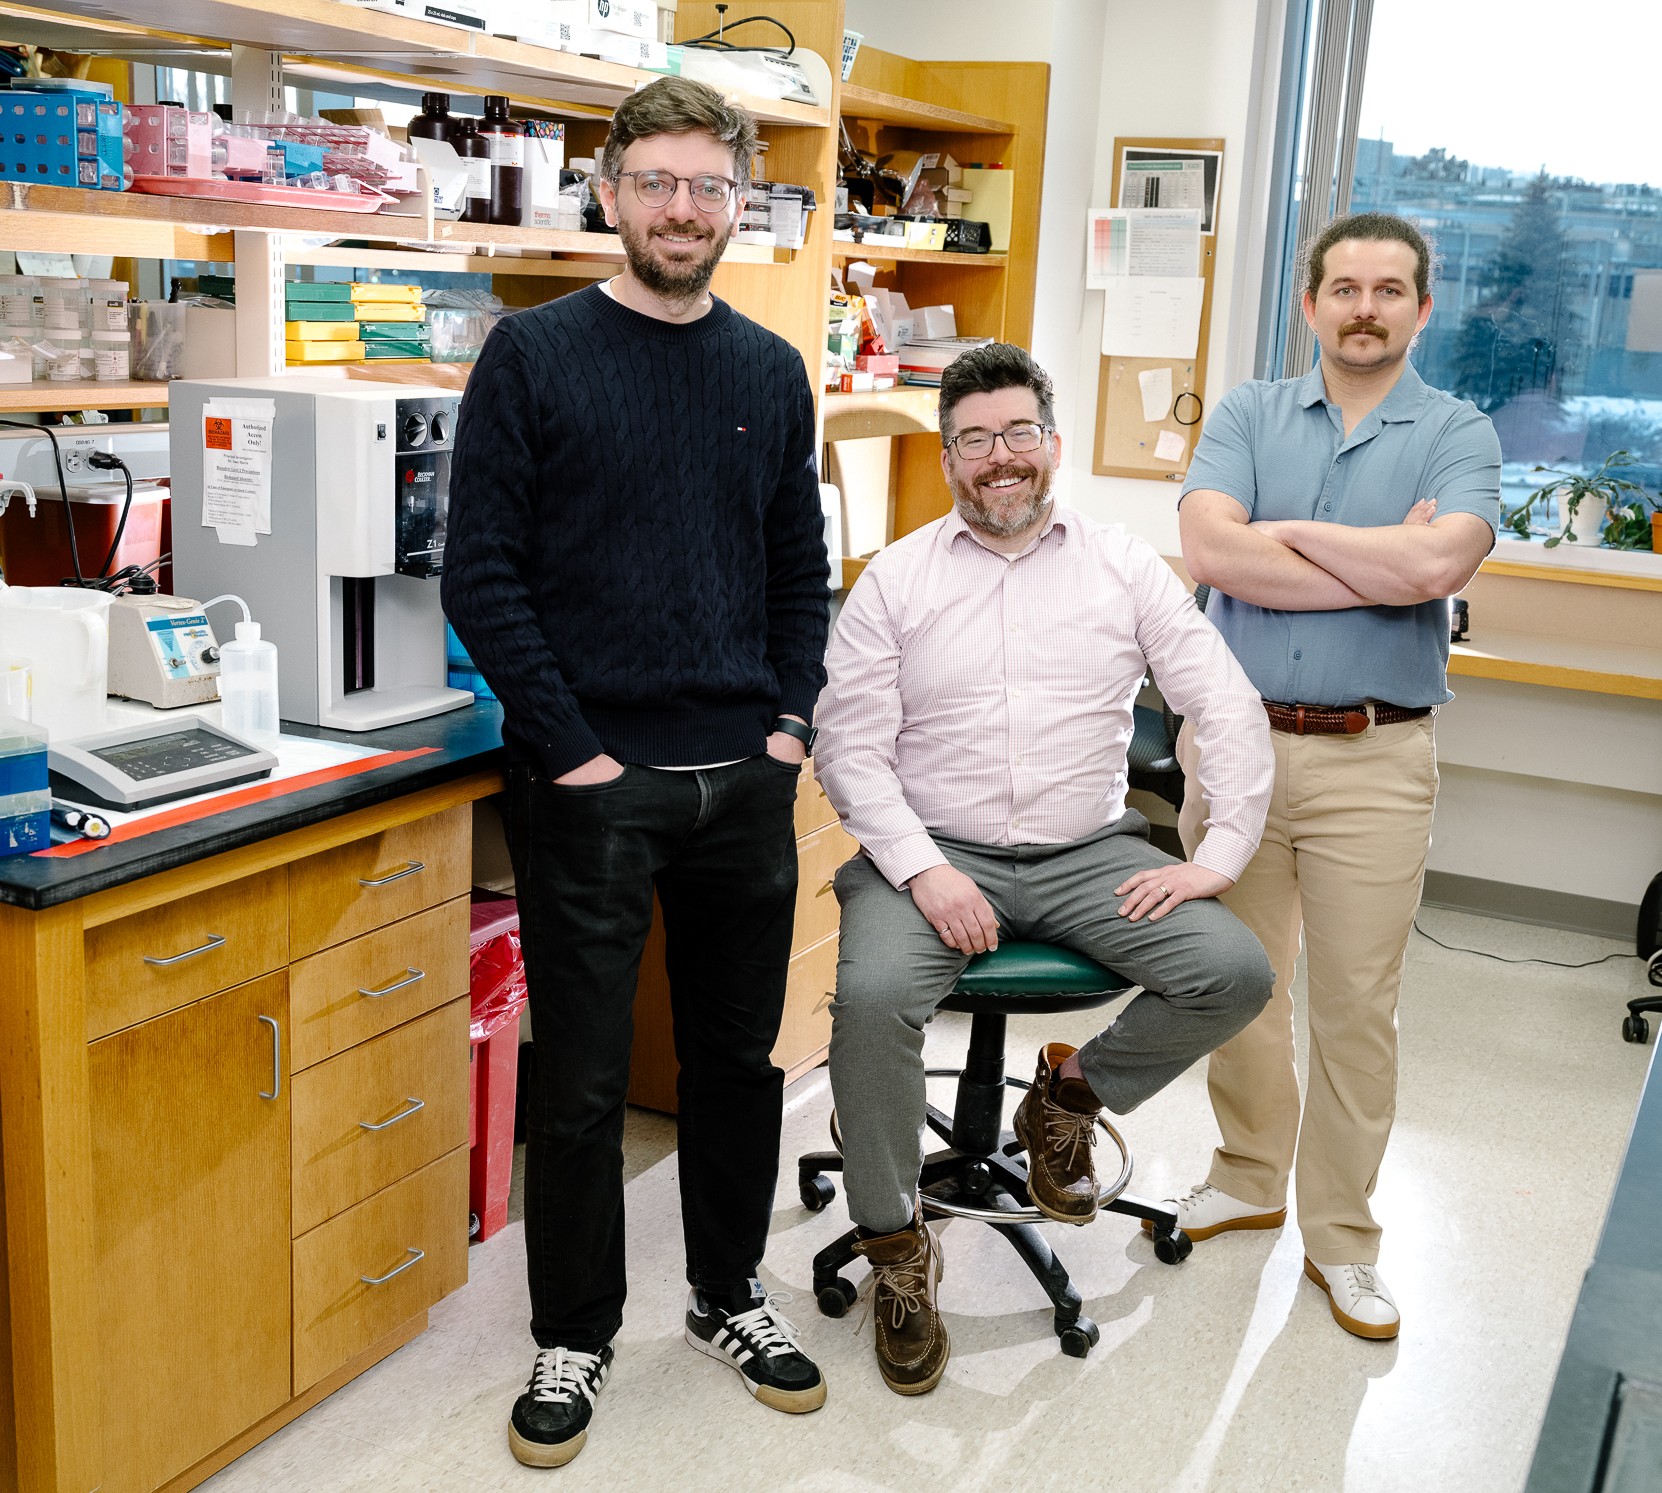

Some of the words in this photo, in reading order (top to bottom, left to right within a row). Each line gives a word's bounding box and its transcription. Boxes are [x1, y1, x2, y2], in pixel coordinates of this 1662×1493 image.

[598, 0, 609, 18] hp
[534, 211, 551, 219] thermo
[426, 539, 436, 548] Z1
